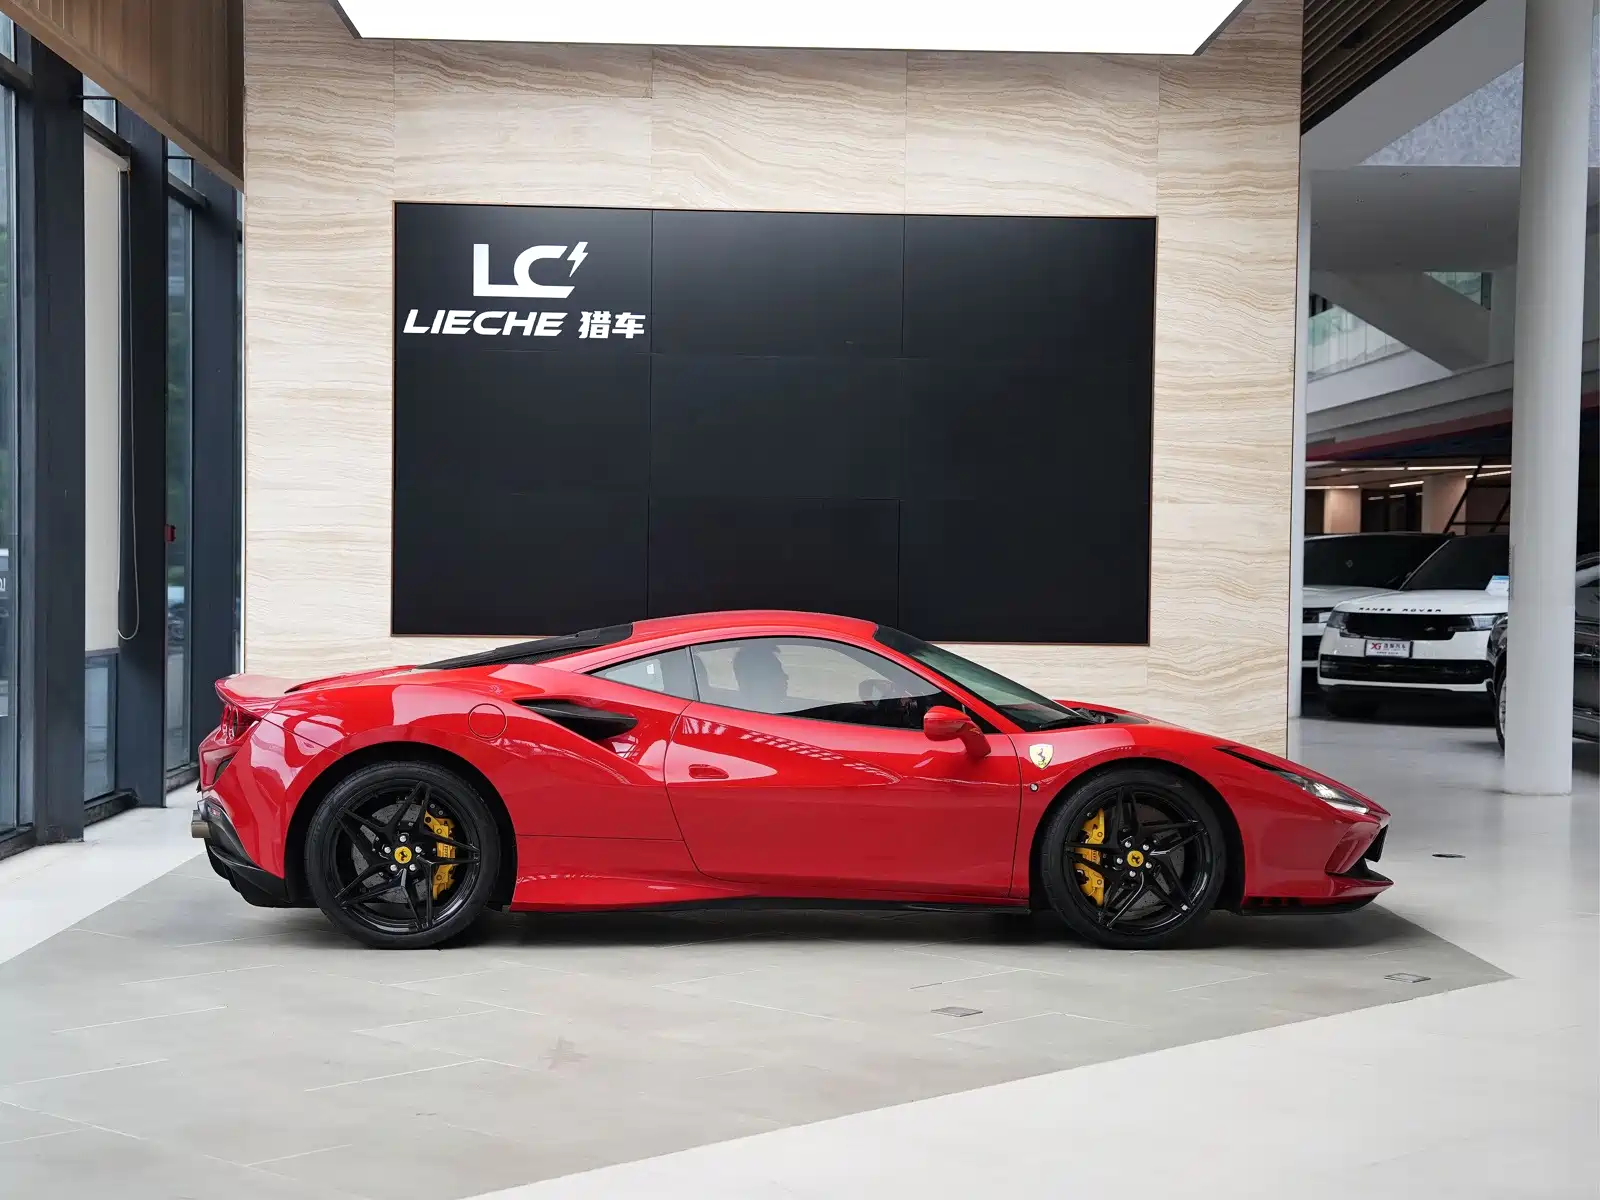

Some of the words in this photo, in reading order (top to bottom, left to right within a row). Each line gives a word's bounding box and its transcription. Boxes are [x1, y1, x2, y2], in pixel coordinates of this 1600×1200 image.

[473, 243, 575, 299] LC
[402, 309, 568, 337] LIECHE
[578, 310, 646, 339] 猎车
